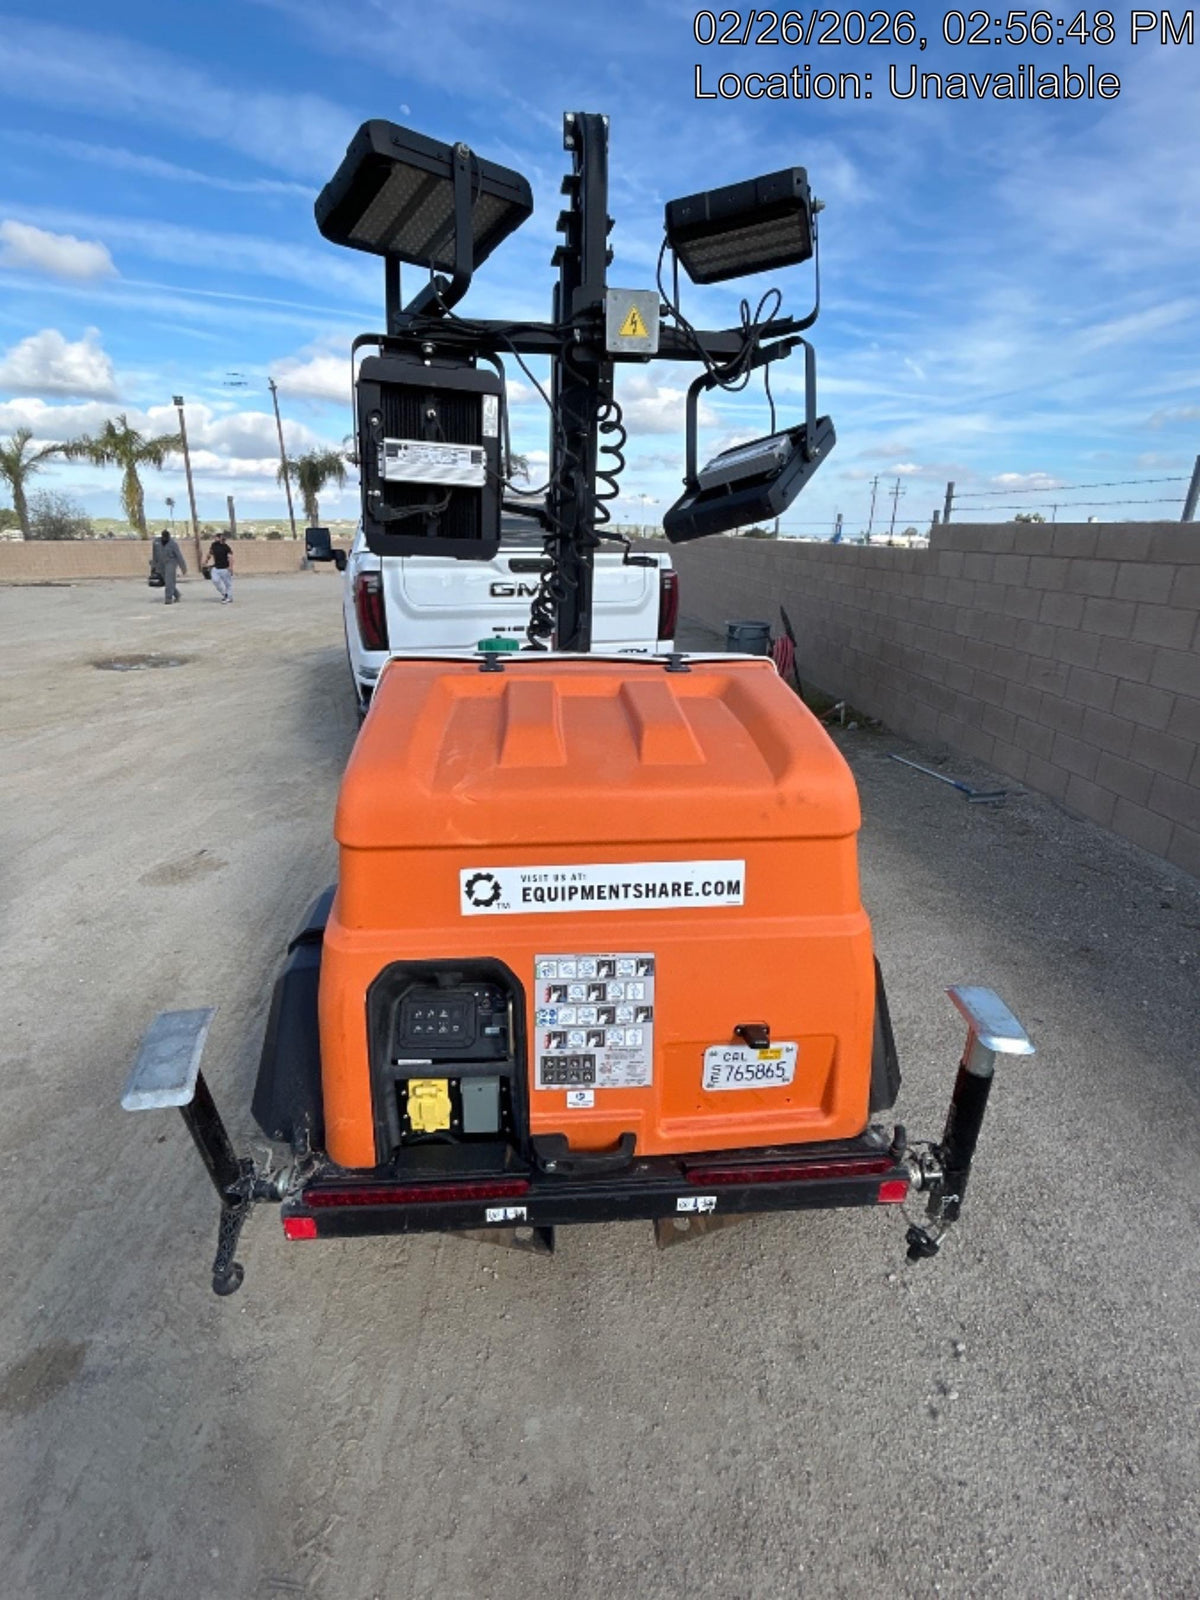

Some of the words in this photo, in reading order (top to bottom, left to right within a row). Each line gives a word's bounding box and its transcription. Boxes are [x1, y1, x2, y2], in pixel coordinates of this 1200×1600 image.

[490, 582, 542, 598] GM
[520, 874, 548, 883] VISIT
[553, 874, 566, 882] US
[570, 872, 587, 881] AT:
[522, 879, 741, 904] EQUIPMENTSHARE.COM
[723, 1051, 748, 1063] CAL
[725, 1060, 787, 1082] 765865
